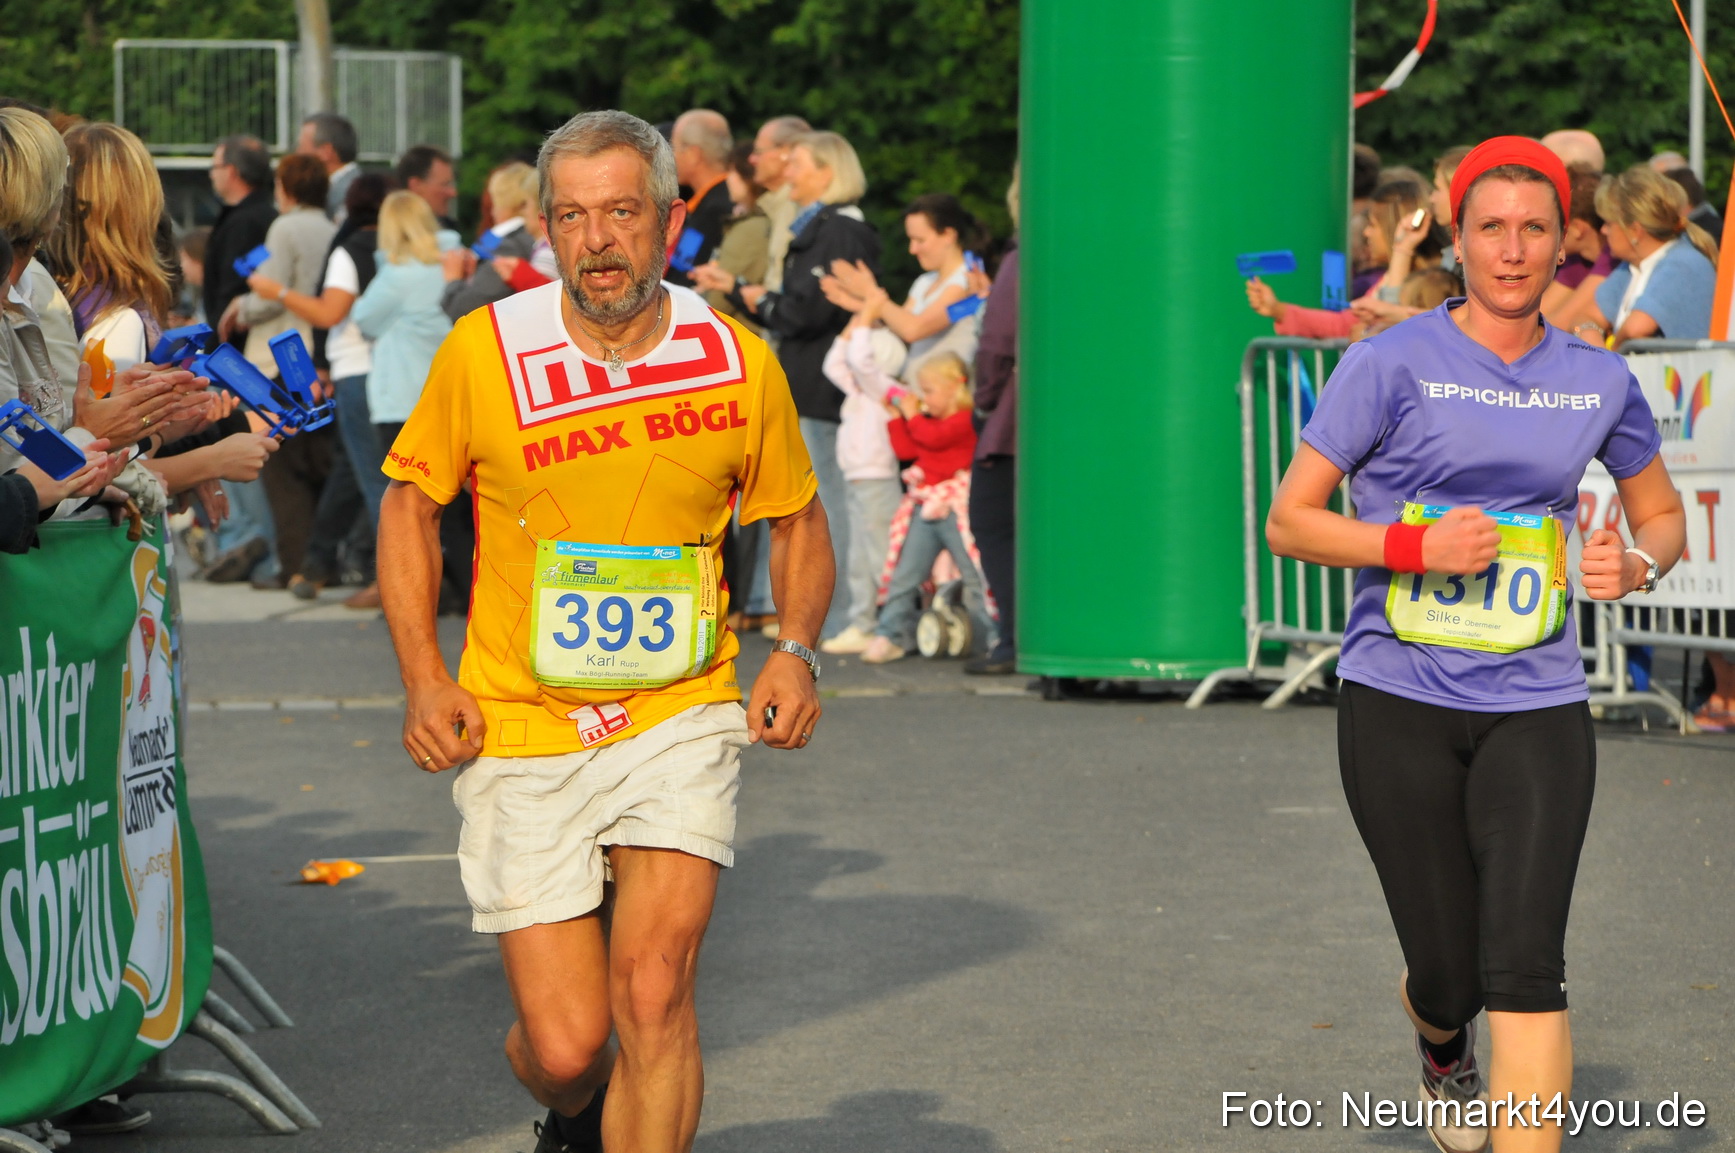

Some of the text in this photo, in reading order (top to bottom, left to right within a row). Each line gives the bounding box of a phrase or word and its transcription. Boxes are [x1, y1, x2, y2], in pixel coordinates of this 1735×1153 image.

[1419, 379, 1601, 410] TEPPICHLÄUFER
[522, 400, 747, 472] MAX BÖGL
[560, 571, 619, 586] firmenlauf
[1410, 562, 1541, 615] 1310
[552, 593, 675, 652] 393
[1426, 609, 1501, 629] Silke Obermeier
[586, 654, 639, 668] Karl Rupp
